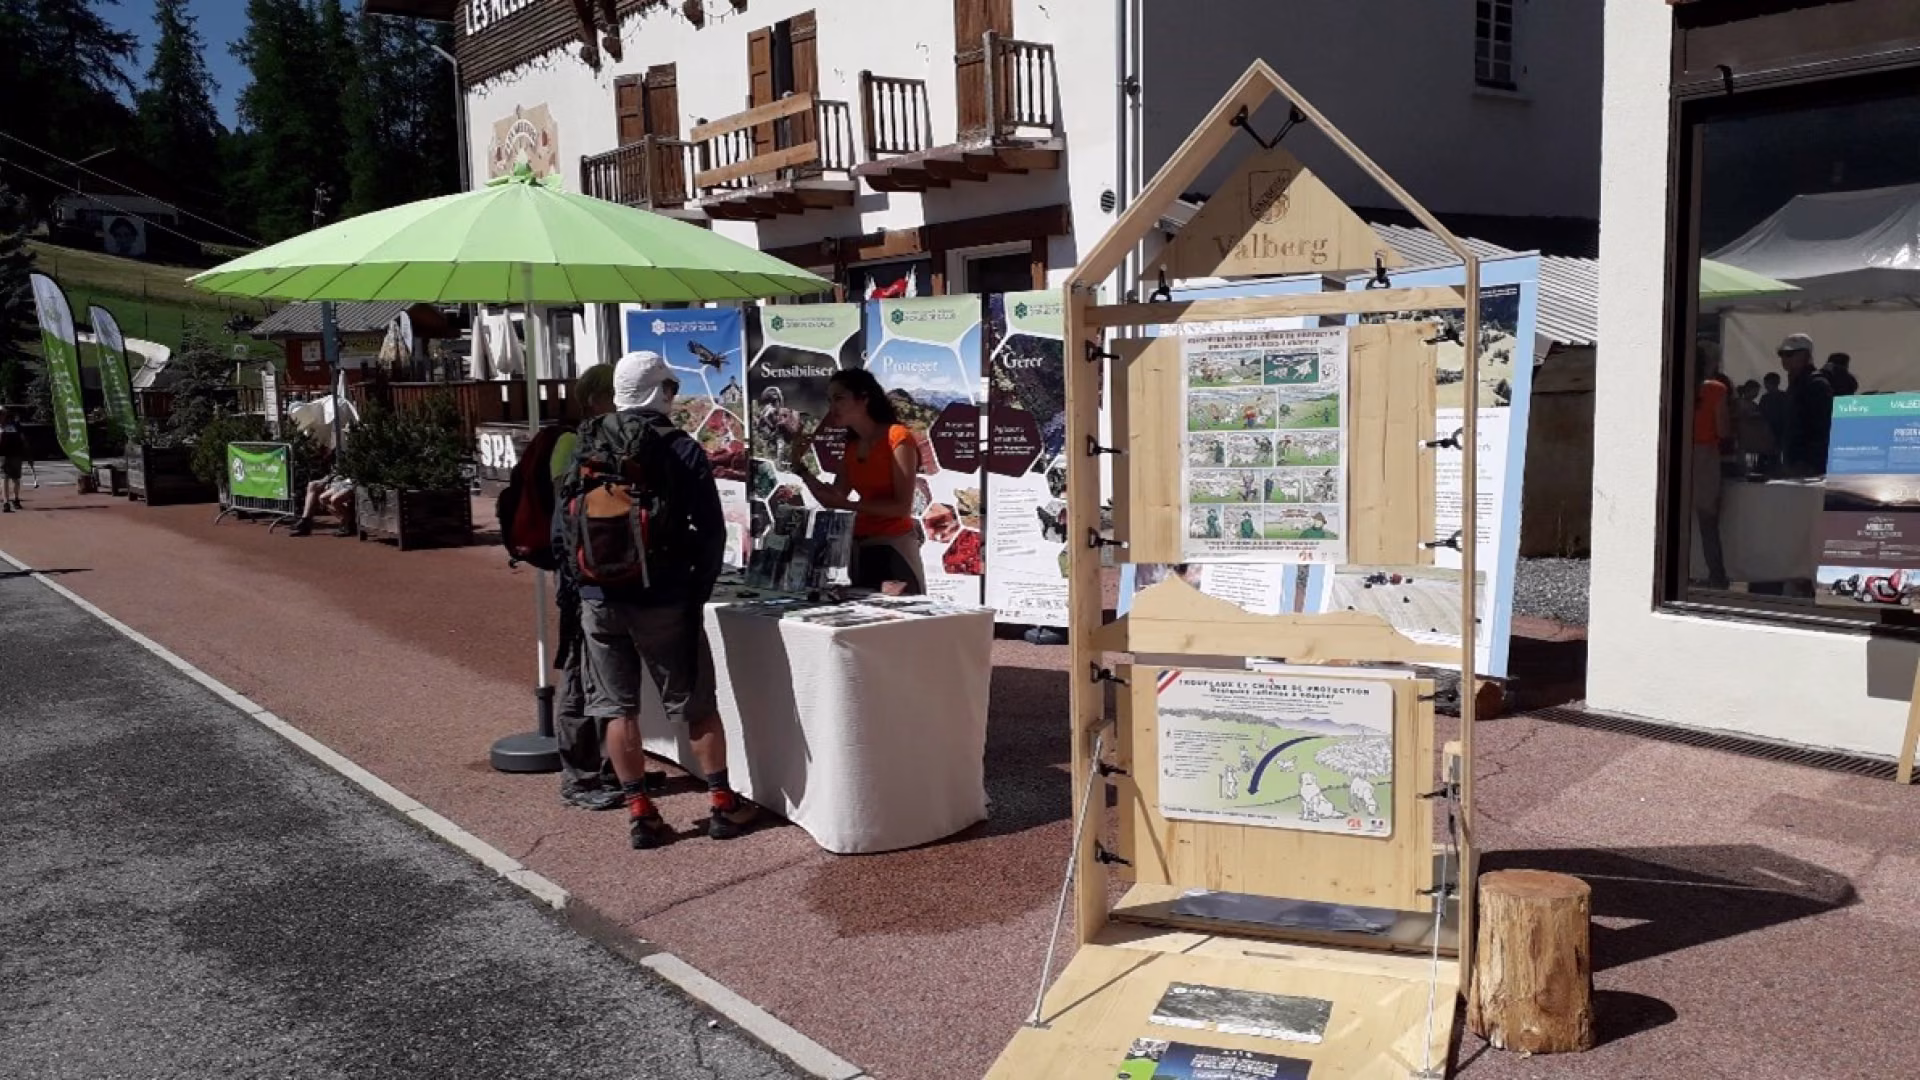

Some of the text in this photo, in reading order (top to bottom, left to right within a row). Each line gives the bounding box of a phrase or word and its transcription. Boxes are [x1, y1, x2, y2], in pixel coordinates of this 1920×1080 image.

[465, 0, 488, 36] LES
[1210, 233, 1328, 265] Valberg
[760, 362, 834, 377] Sensibiliser
[1003, 352, 1043, 369] Gérer
[480, 433, 518, 469] SPA
[1308, 685, 1370, 696] PROTECTION
